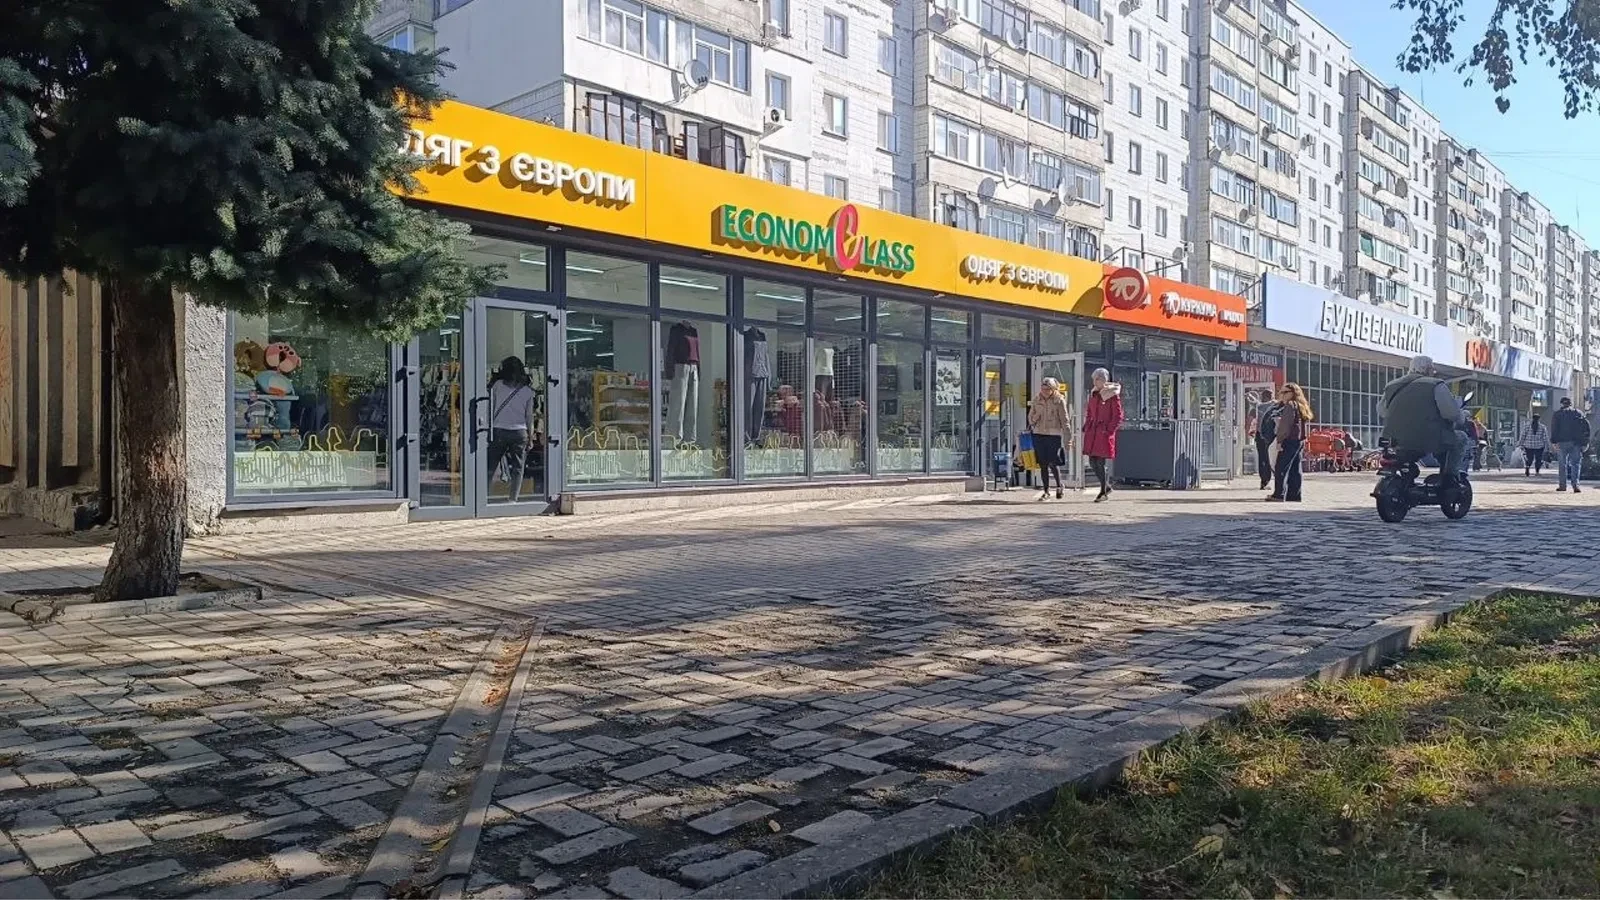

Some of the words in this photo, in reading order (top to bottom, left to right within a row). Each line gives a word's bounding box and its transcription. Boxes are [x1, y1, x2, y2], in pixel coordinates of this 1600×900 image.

[398, 128, 474, 168] ДЯГ
[477, 145, 501, 175] З
[510, 152, 637, 204] ЄВРОПИ
[965, 254, 1004, 279] ОДЯГ
[1004, 263, 1017, 281] З
[1017, 265, 1070, 291] ЄВРОПИ
[1320, 300, 1426, 354] БУДІВЕЛЬНИЙ
